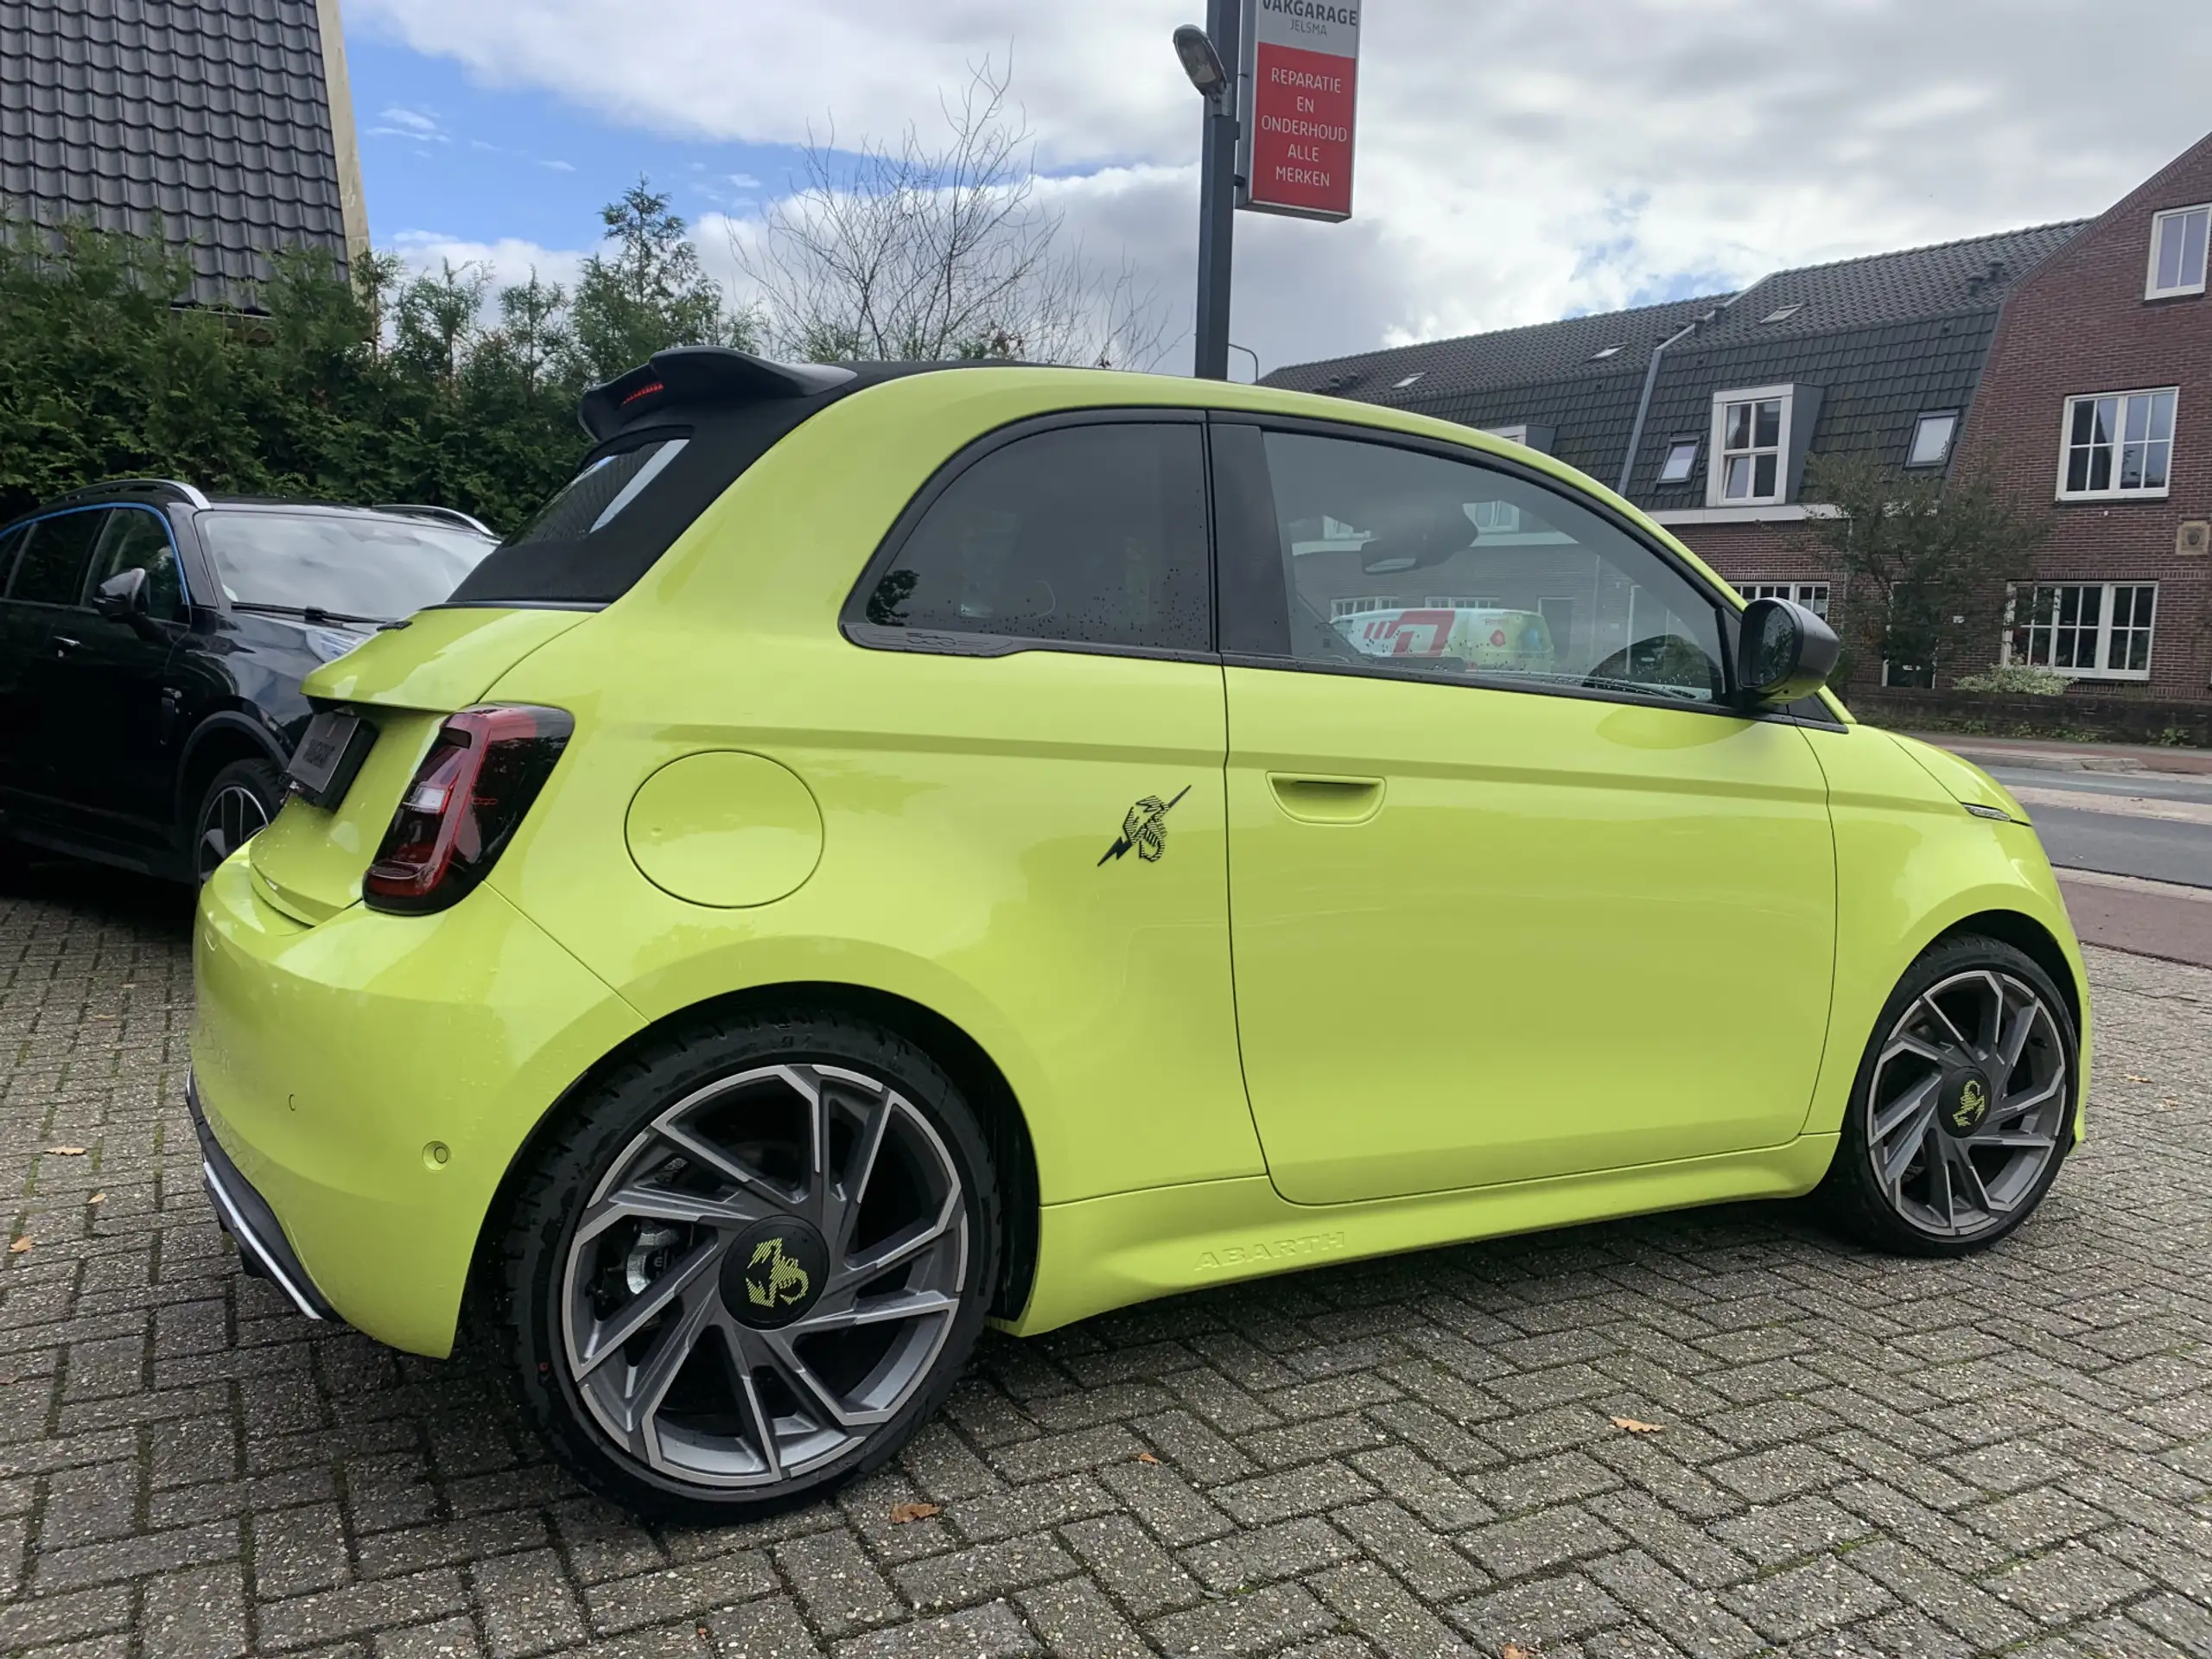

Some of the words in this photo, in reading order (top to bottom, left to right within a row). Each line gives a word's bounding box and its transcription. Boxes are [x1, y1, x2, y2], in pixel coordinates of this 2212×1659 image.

[1262, 0, 1357, 26] VAKGARAGE
[1289, 19, 1328, 35] JELSMA
[1271, 67, 1341, 93] REPARATIE
[1296, 96, 1314, 113] EN
[1261, 115, 1347, 142] ONDERHOUD
[1287, 144, 1319, 162] ALLE
[1275, 166, 1330, 187] MERKEN
[1193, 1231, 1344, 1271] ABARTH
